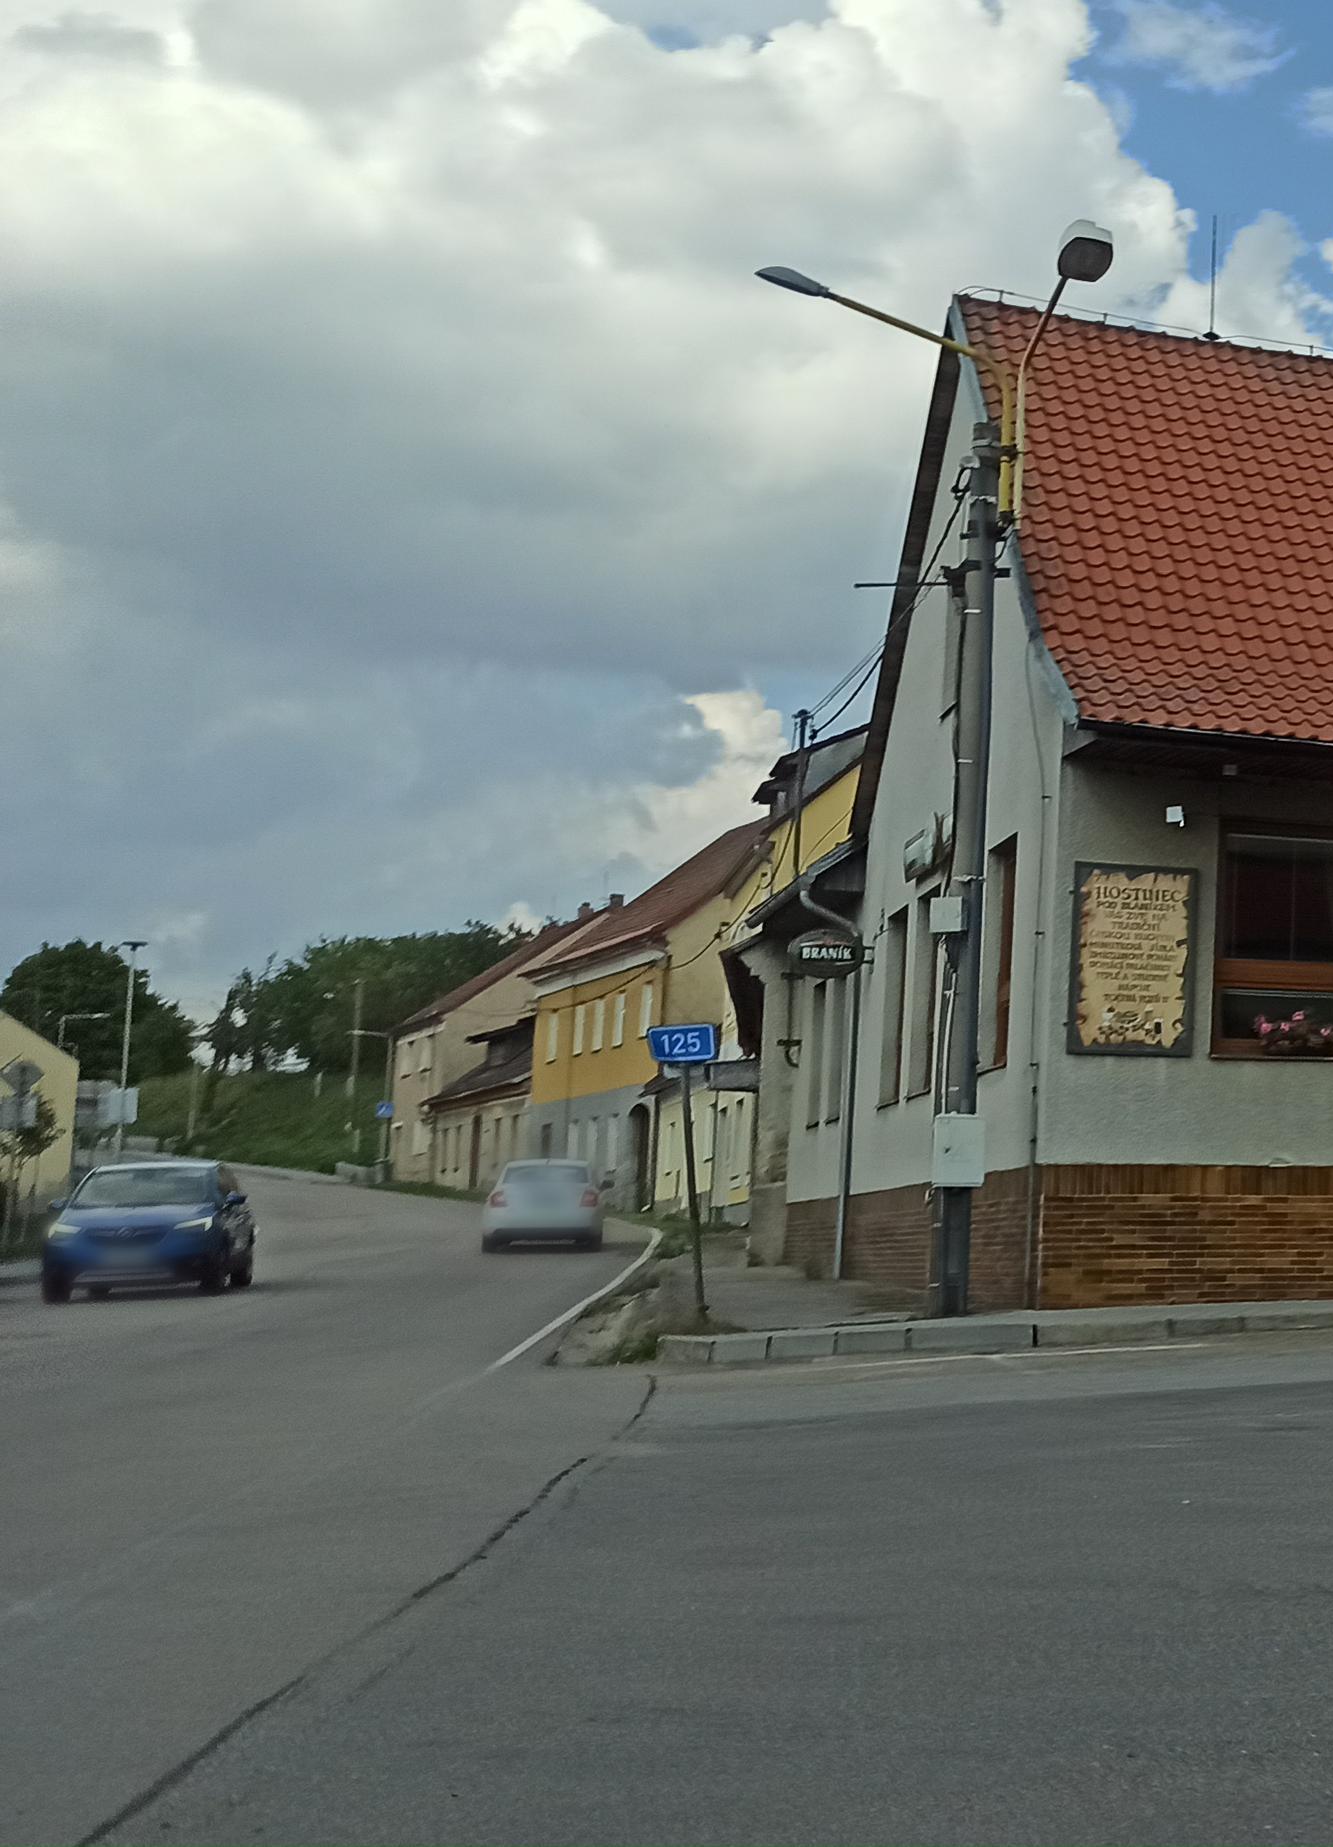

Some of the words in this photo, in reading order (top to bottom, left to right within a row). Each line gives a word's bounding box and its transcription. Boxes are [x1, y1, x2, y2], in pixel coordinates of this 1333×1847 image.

[1096, 885, 1181, 902] HOSTINEC
[802, 945, 852, 960] BRANÍK
[660, 1031, 701, 1055] 125
